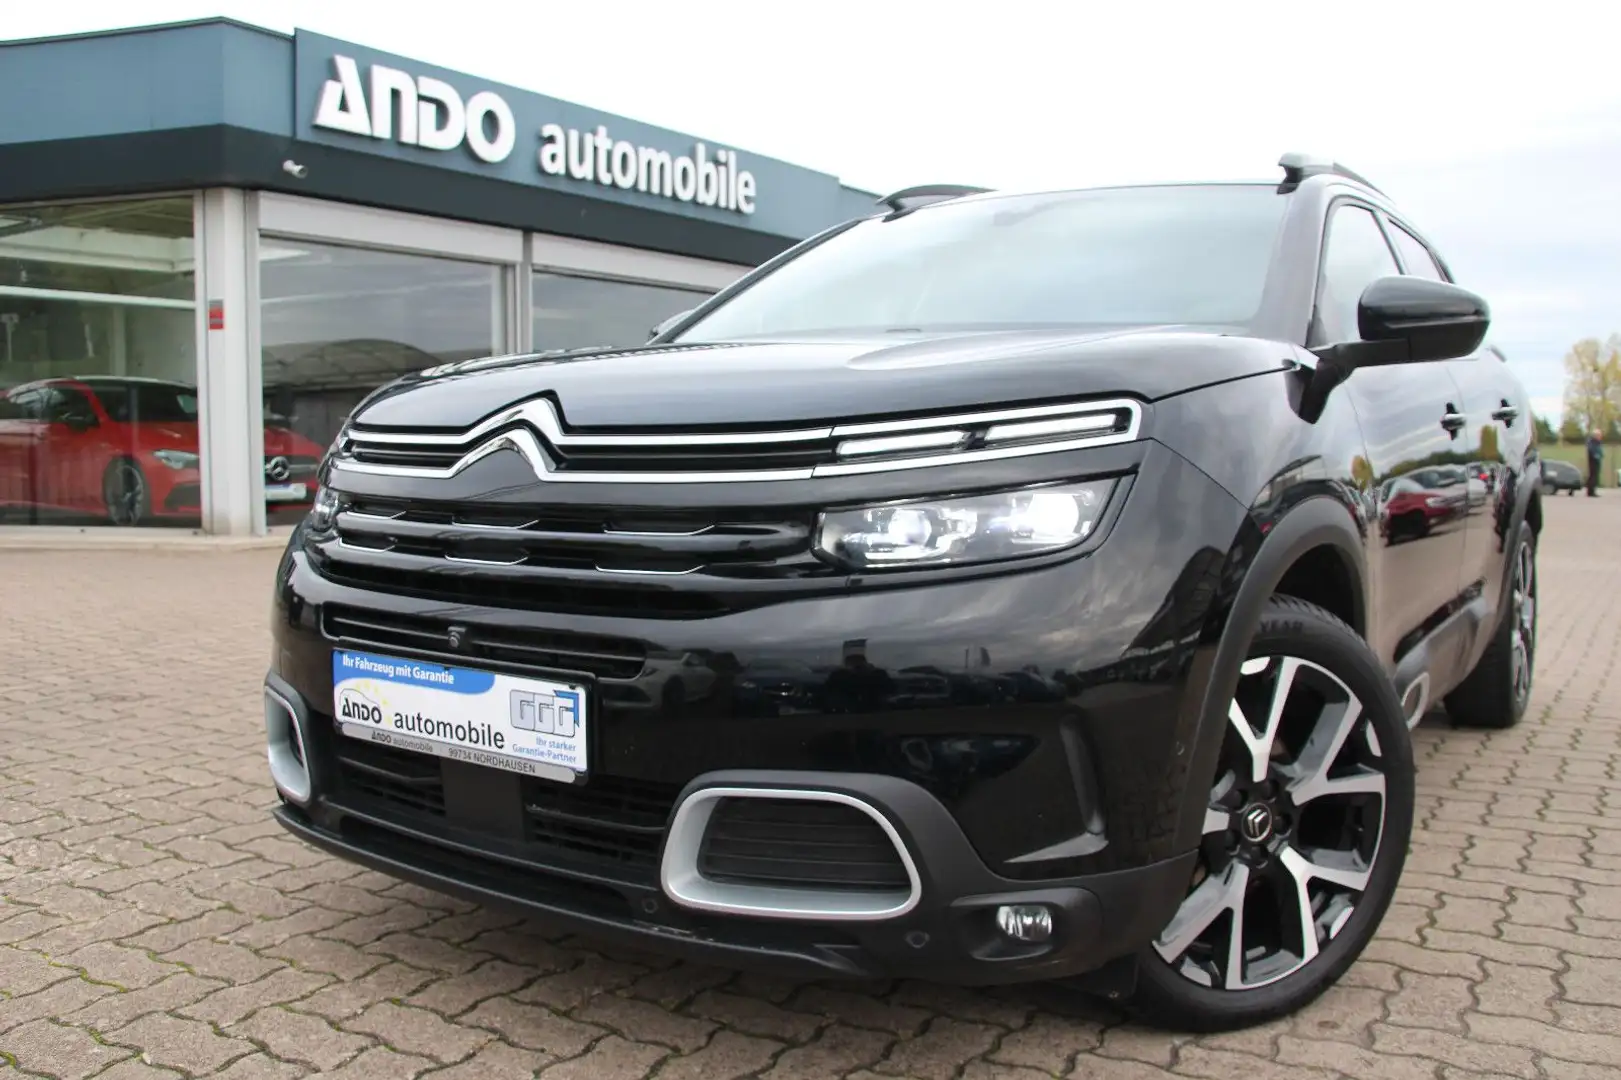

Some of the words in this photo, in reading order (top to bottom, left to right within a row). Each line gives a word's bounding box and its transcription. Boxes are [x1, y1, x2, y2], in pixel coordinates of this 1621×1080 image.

[312, 54, 516, 163] ANDO
[538, 121, 757, 215] automobile
[342, 654, 354, 667] Ihr
[355, 657, 394, 678] Fahrzeug
[396, 664, 411, 678] mit
[412, 666, 455, 685] Garantie
[342, 697, 382, 724] ANDO
[394, 711, 505, 750] automobile
[393, 738, 433, 753] automobile
[512, 743, 577, 764] Garantie-Partner
[548, 740, 576, 752] starker
[448, 747, 472, 761] 99734
[473, 752, 536, 774] NORDHAUSEN
